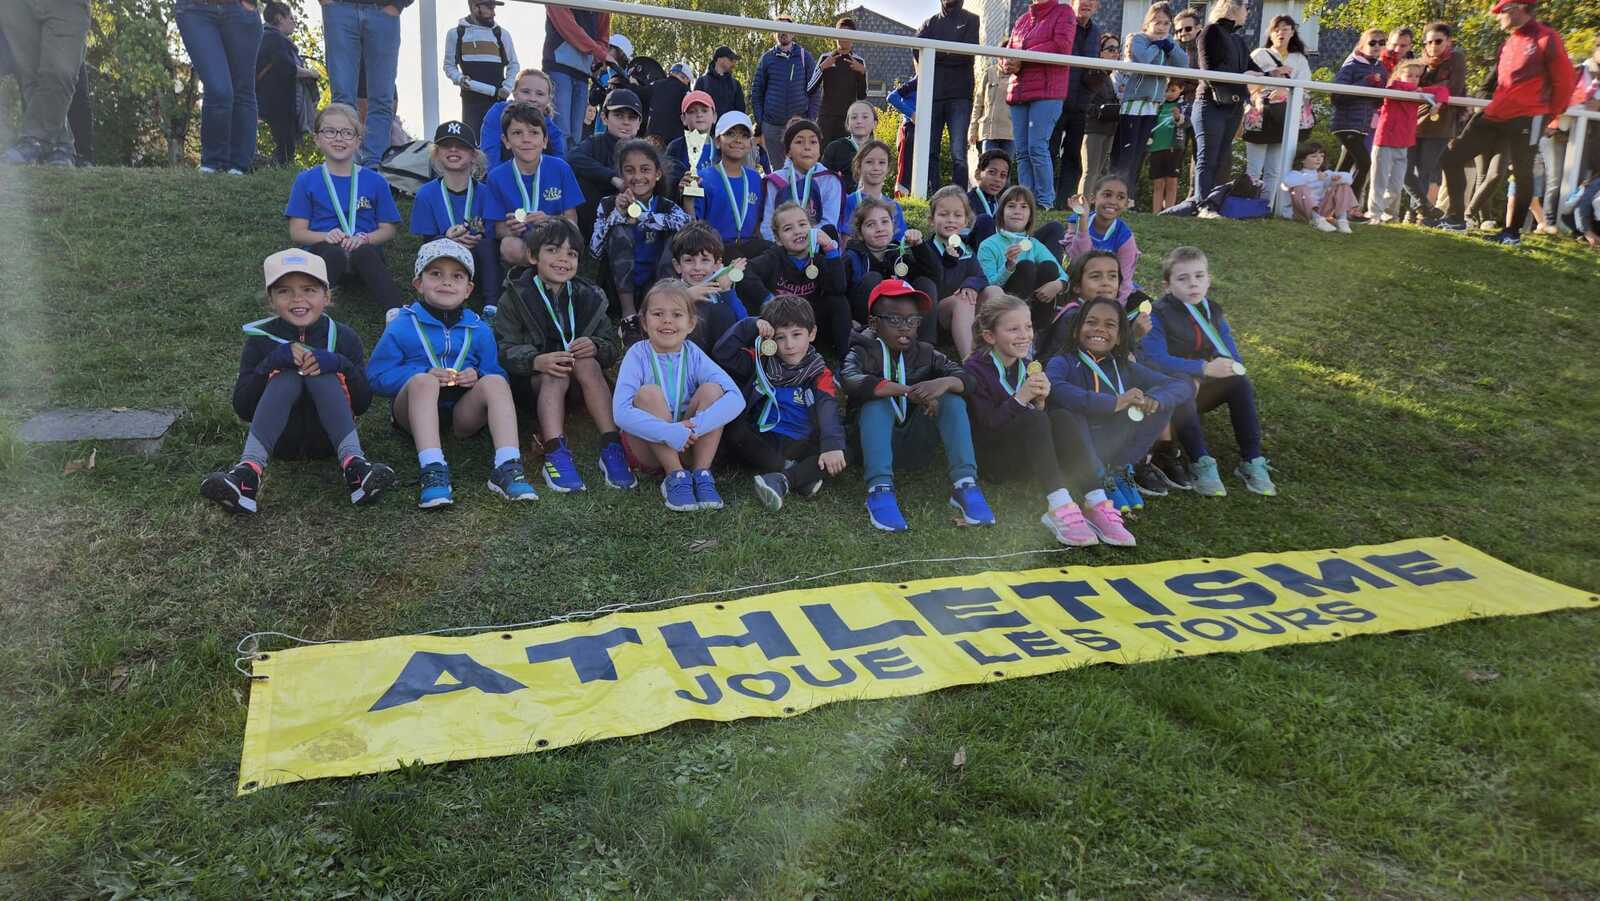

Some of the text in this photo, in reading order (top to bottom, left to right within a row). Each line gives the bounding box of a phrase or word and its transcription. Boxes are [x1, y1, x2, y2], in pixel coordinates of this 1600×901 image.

[368, 550, 1477, 712] ATHLETISME
[675, 601, 1378, 705] JOUE LES TOURS
